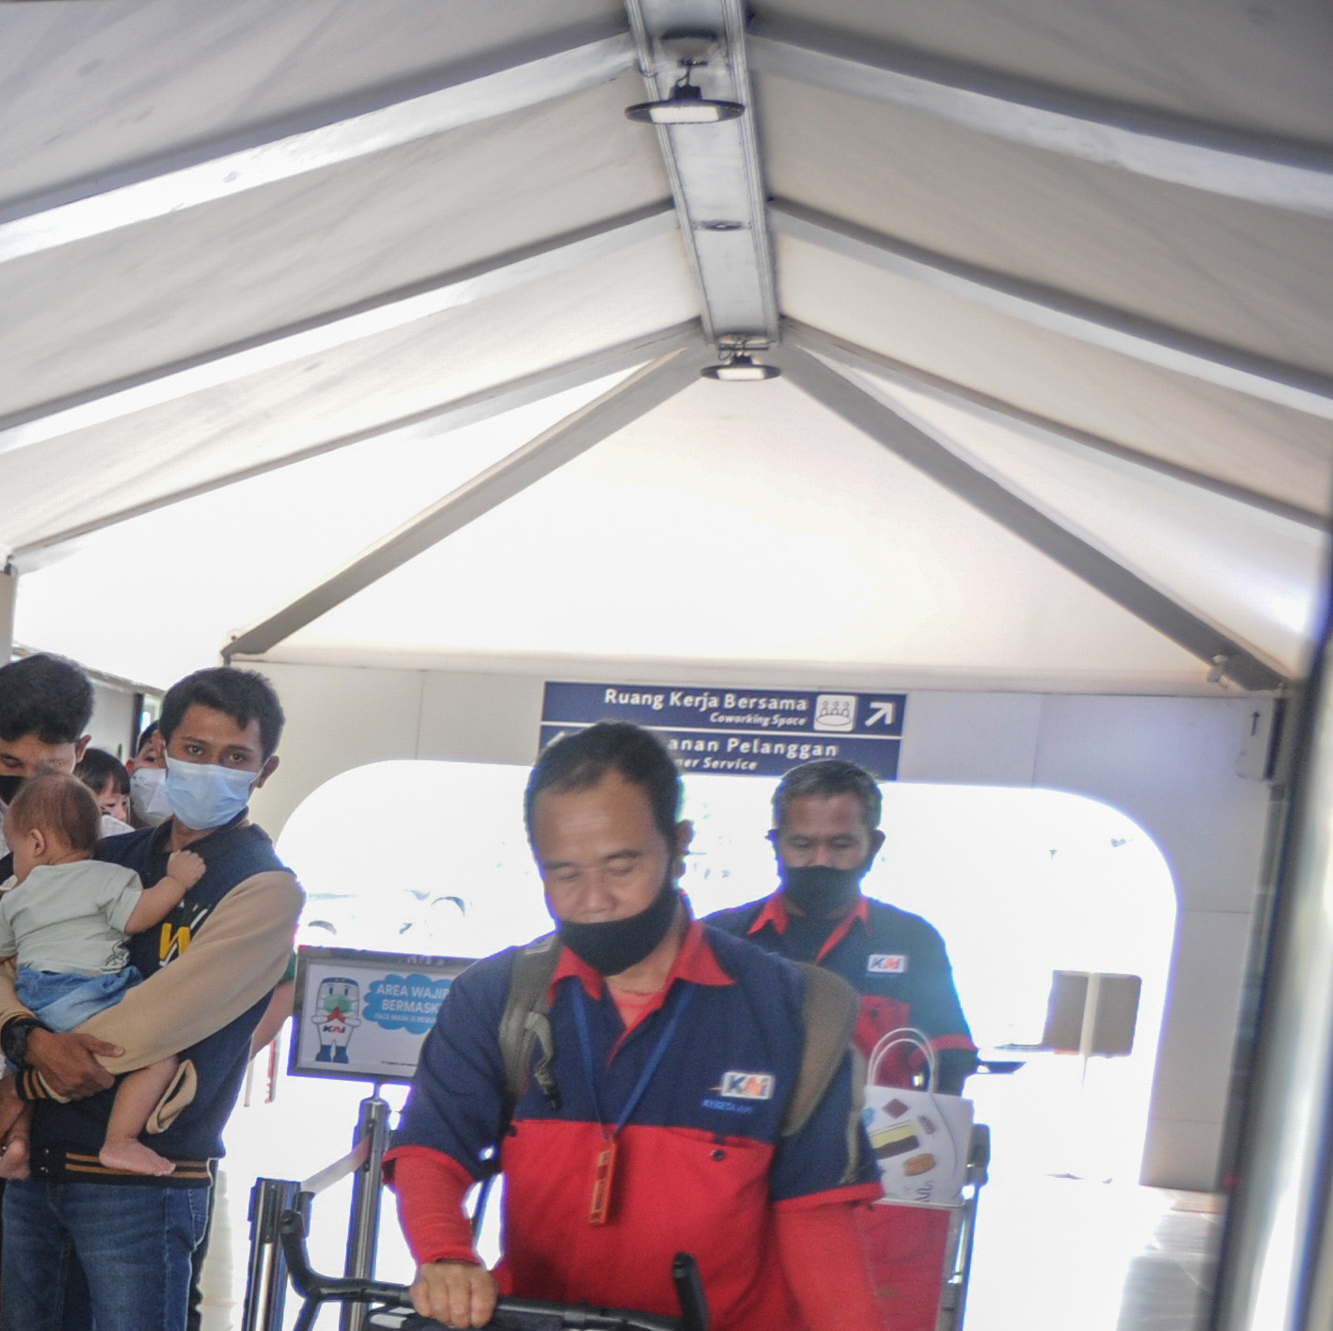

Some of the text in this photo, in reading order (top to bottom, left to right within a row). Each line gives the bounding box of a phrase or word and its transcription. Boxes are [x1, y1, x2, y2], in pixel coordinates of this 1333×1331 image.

[605, 688, 808, 712] Ruang Kerja Bersama
[710, 712, 807, 727] Coworking Space
[668, 738, 839, 760] anan Pelanggan
[703, 757, 757, 770] Service
[376, 983, 409, 997] AREA
[382, 1000, 441, 1014] BERMASK
[323, 1026, 346, 1034] KAI
[726, 1074, 771, 1097] KAI
